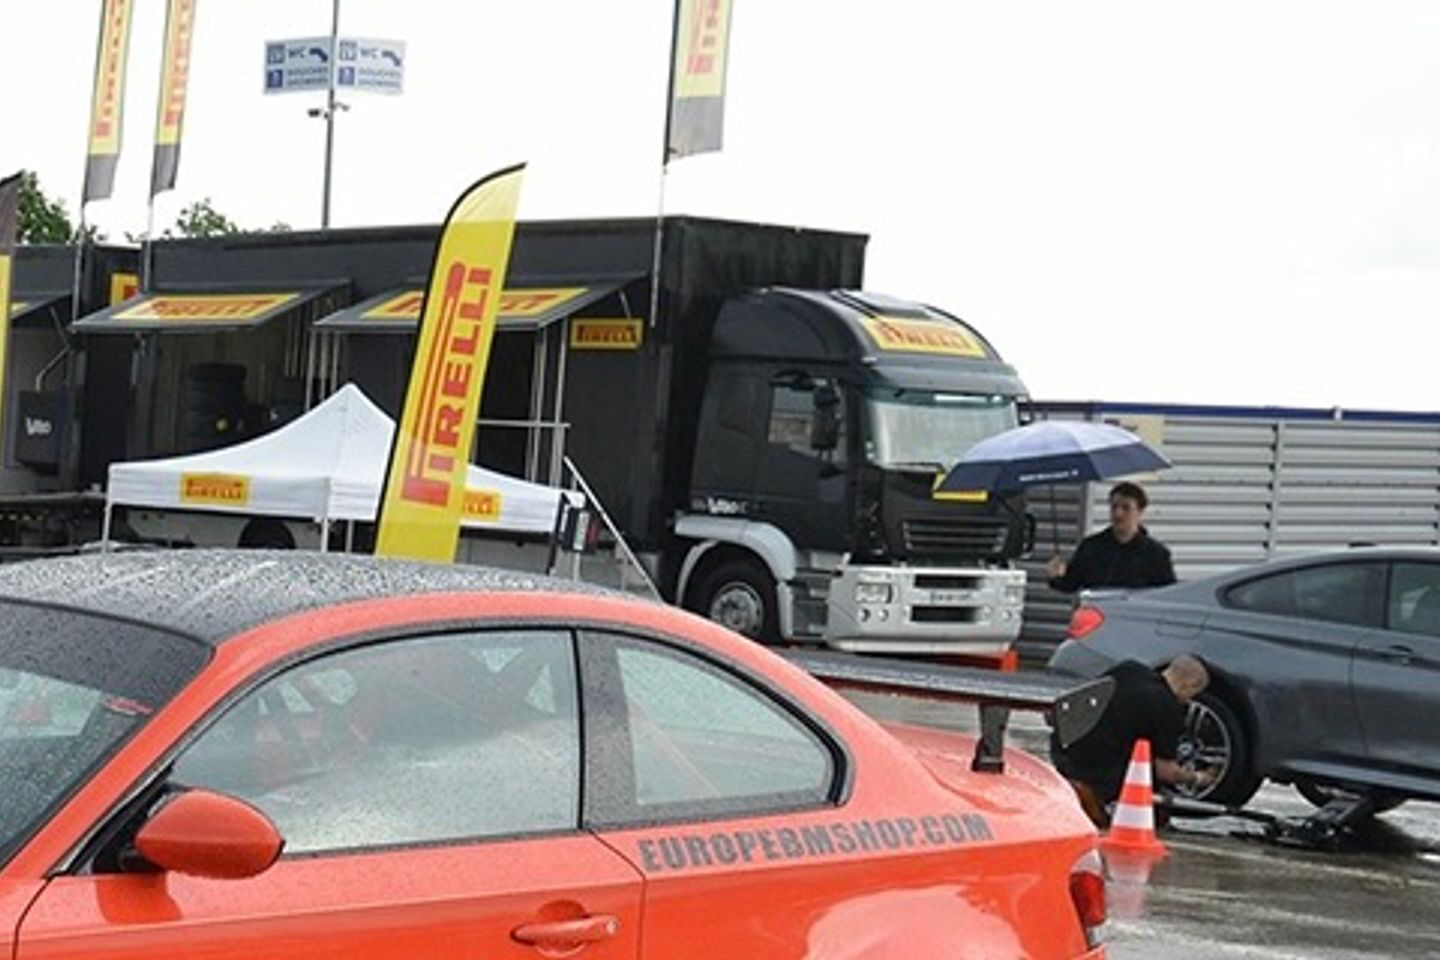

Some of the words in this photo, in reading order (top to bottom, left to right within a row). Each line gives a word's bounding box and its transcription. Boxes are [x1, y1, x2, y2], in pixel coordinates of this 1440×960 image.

[165, 0, 190, 126] PIRELL
[401, 262, 492, 507] PIRELLI
[639, 812, 994, 872] EUROPEBMSHOP.COM
